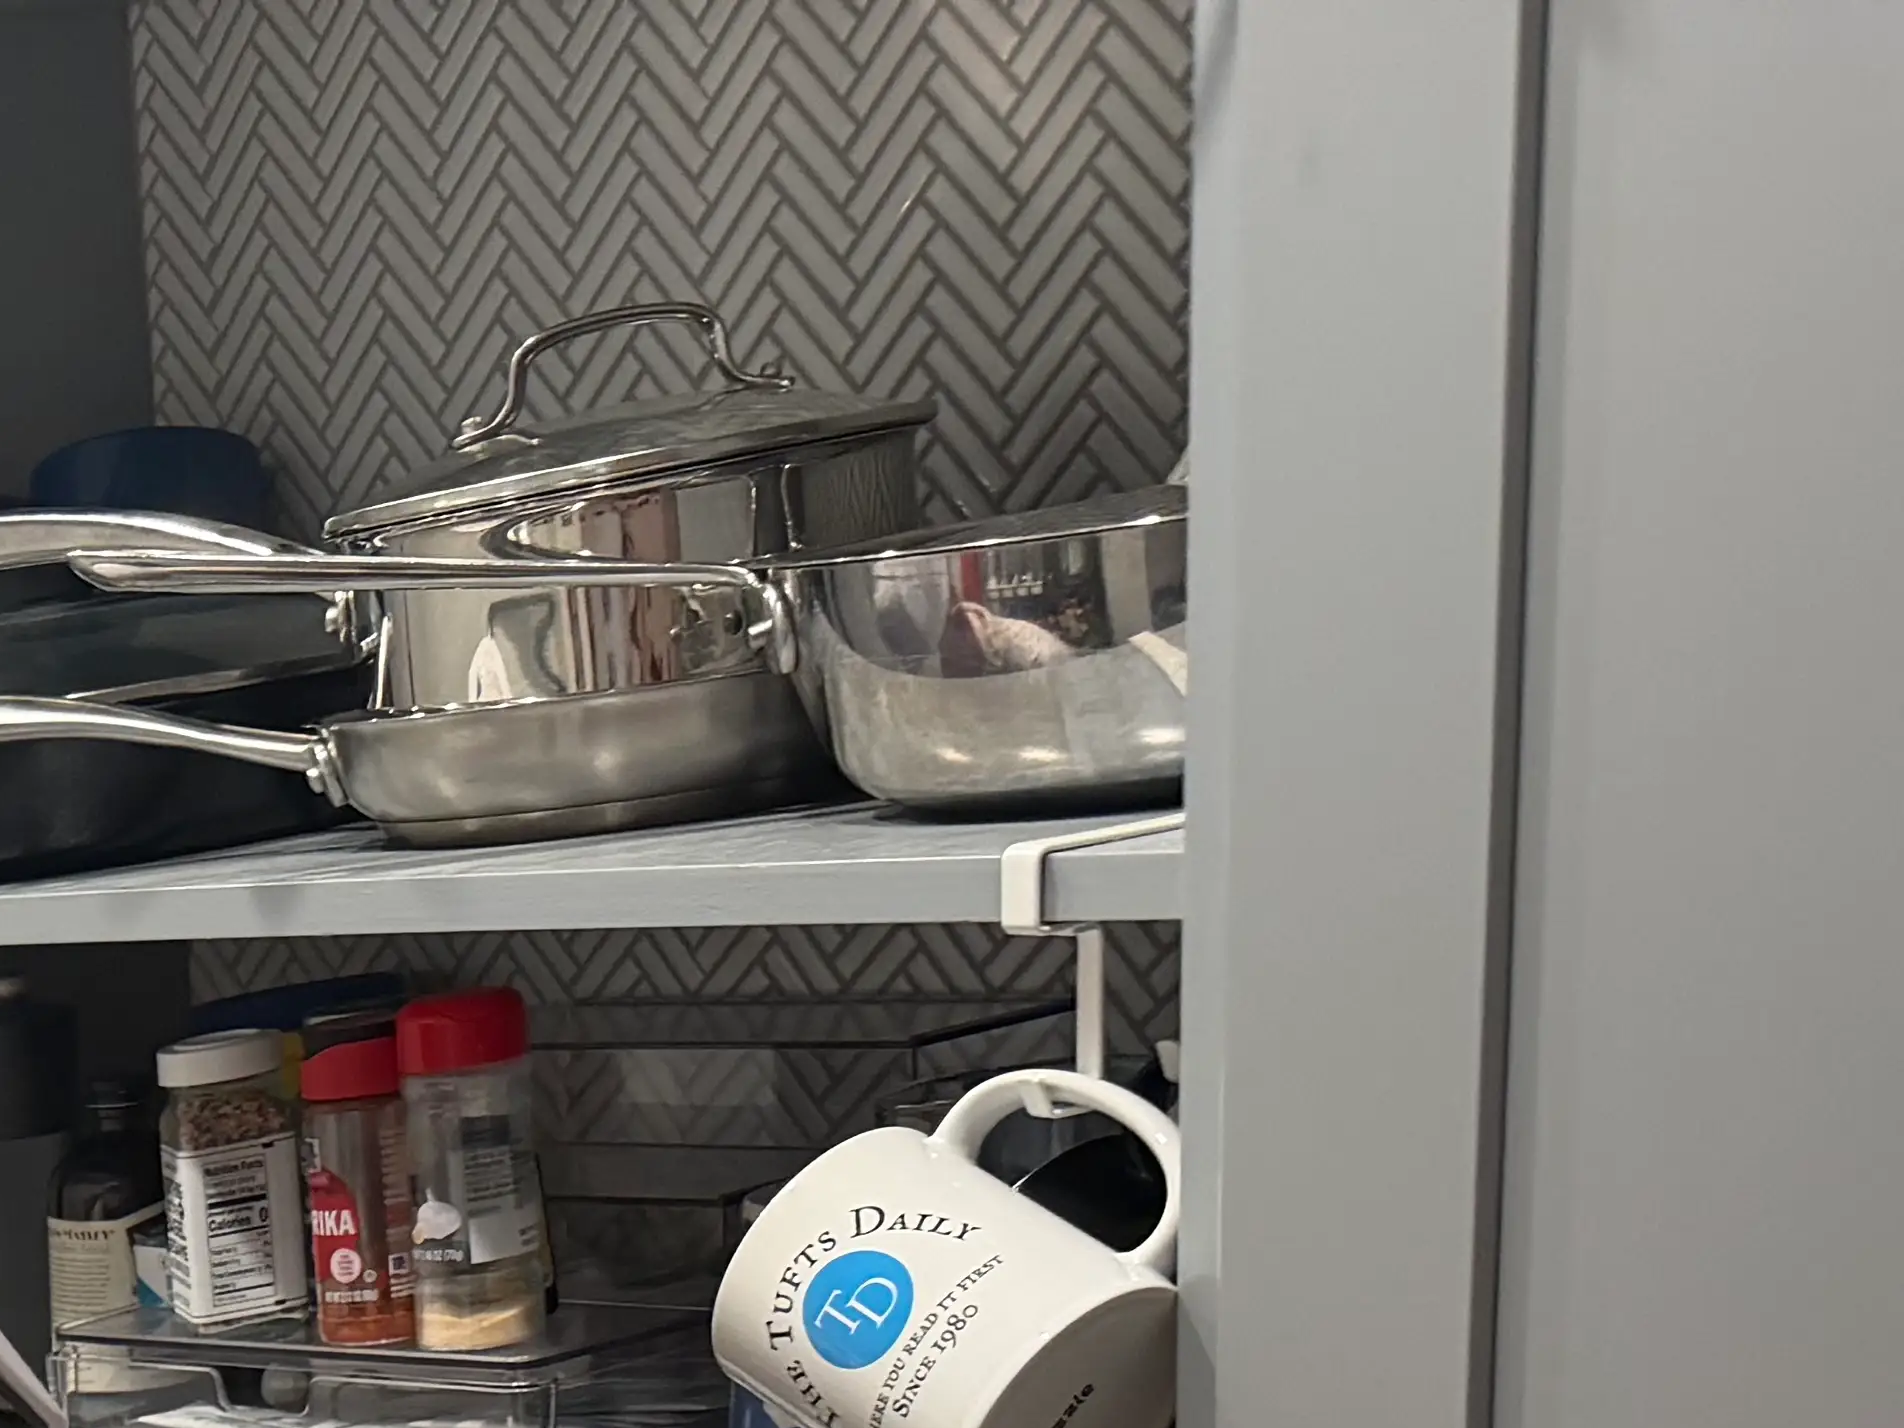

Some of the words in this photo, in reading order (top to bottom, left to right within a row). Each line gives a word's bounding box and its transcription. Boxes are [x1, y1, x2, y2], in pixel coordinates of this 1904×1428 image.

[765, 1230, 838, 1351] TUFTS
[848, 1205, 982, 1242] DAILY
[814, 1276, 899, 1336] TD
[883, 1356, 906, 1391] YOU
[901, 1312, 940, 1356] READ
[936, 1290, 958, 1312] IT
[956, 1253, 1005, 1293] FIRST
[930, 1303, 980, 1355] 1980
